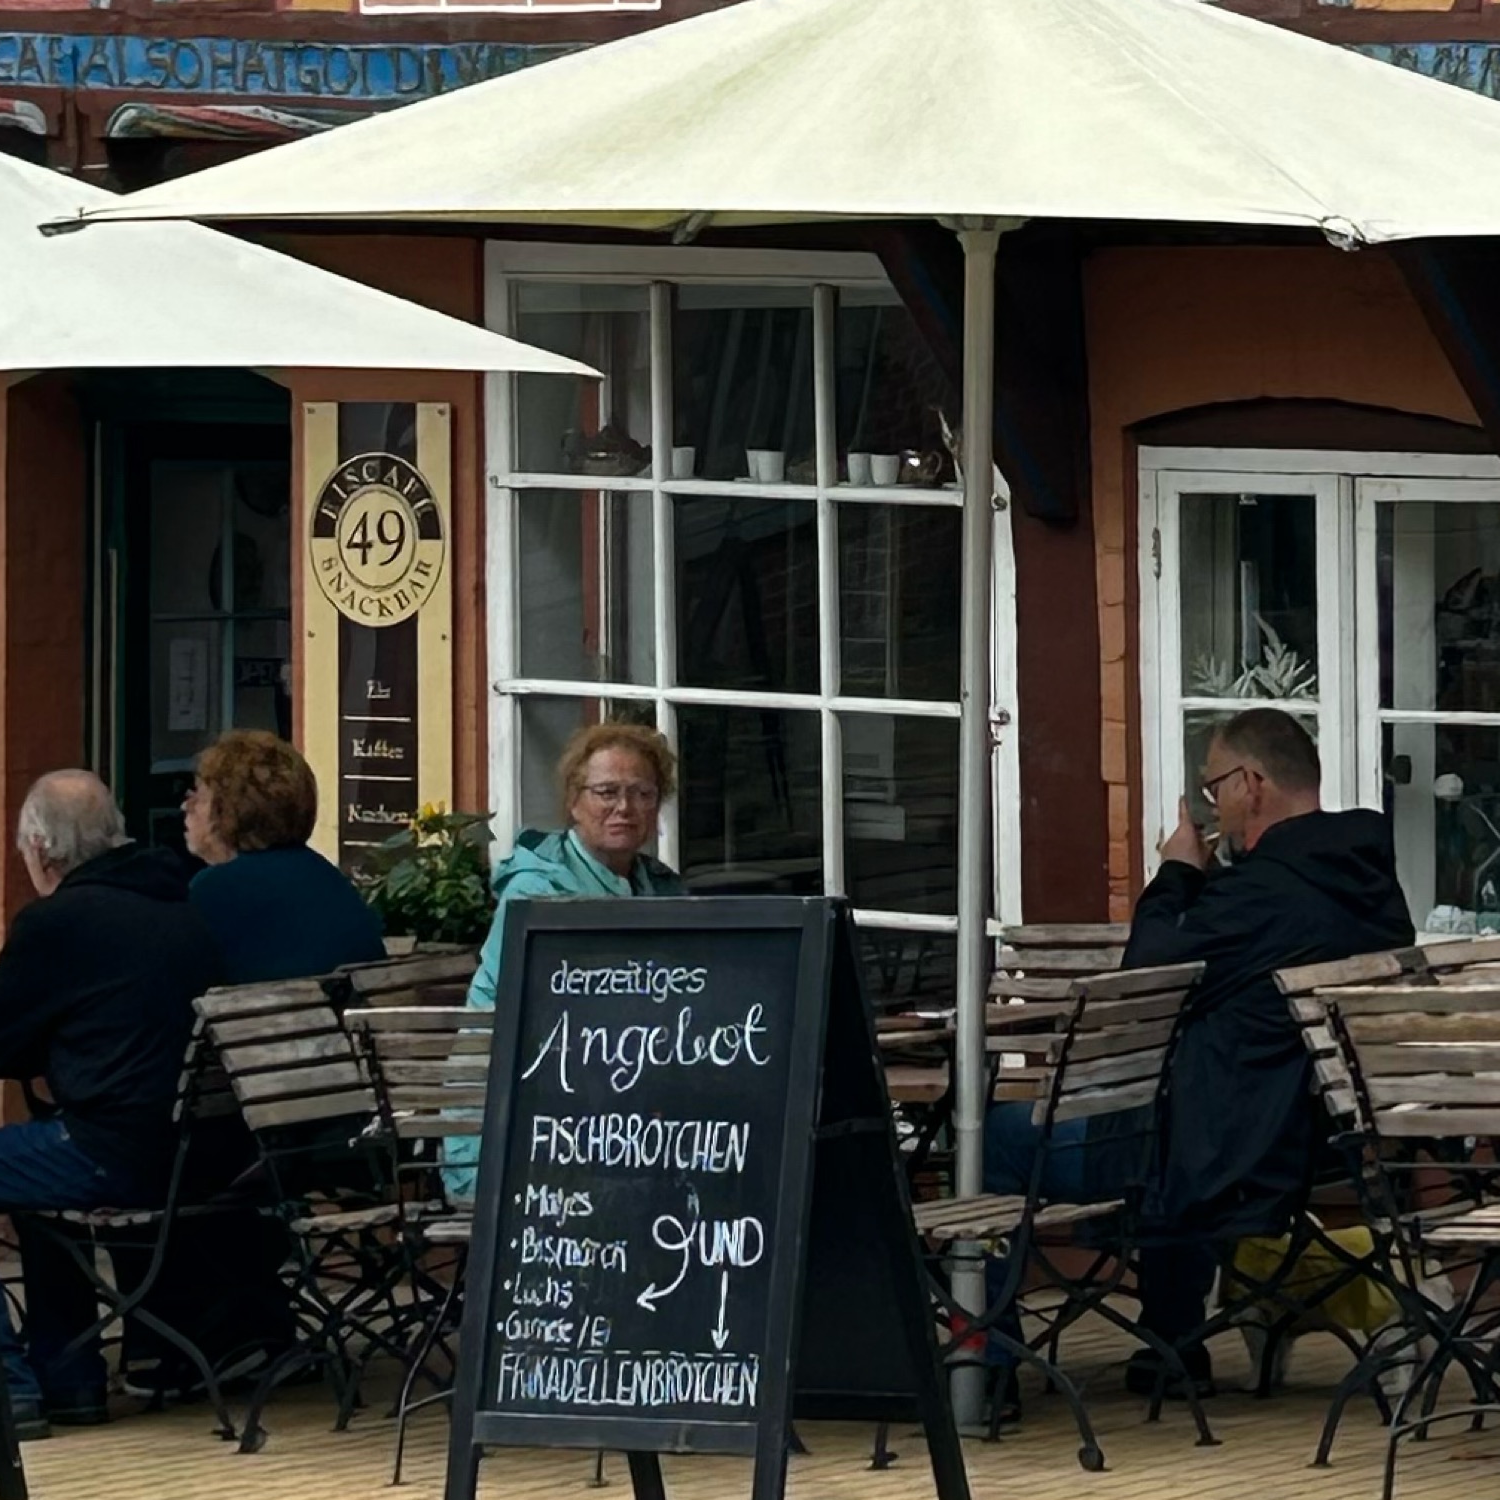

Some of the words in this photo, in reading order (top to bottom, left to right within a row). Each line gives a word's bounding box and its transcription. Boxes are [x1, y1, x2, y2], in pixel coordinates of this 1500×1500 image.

[346, 509, 406, 567] 49
[551, 960, 708, 1003] derzeitiges
[521, 1002, 771, 1093] Angebot
[699, 1215, 764, 1268] UND
